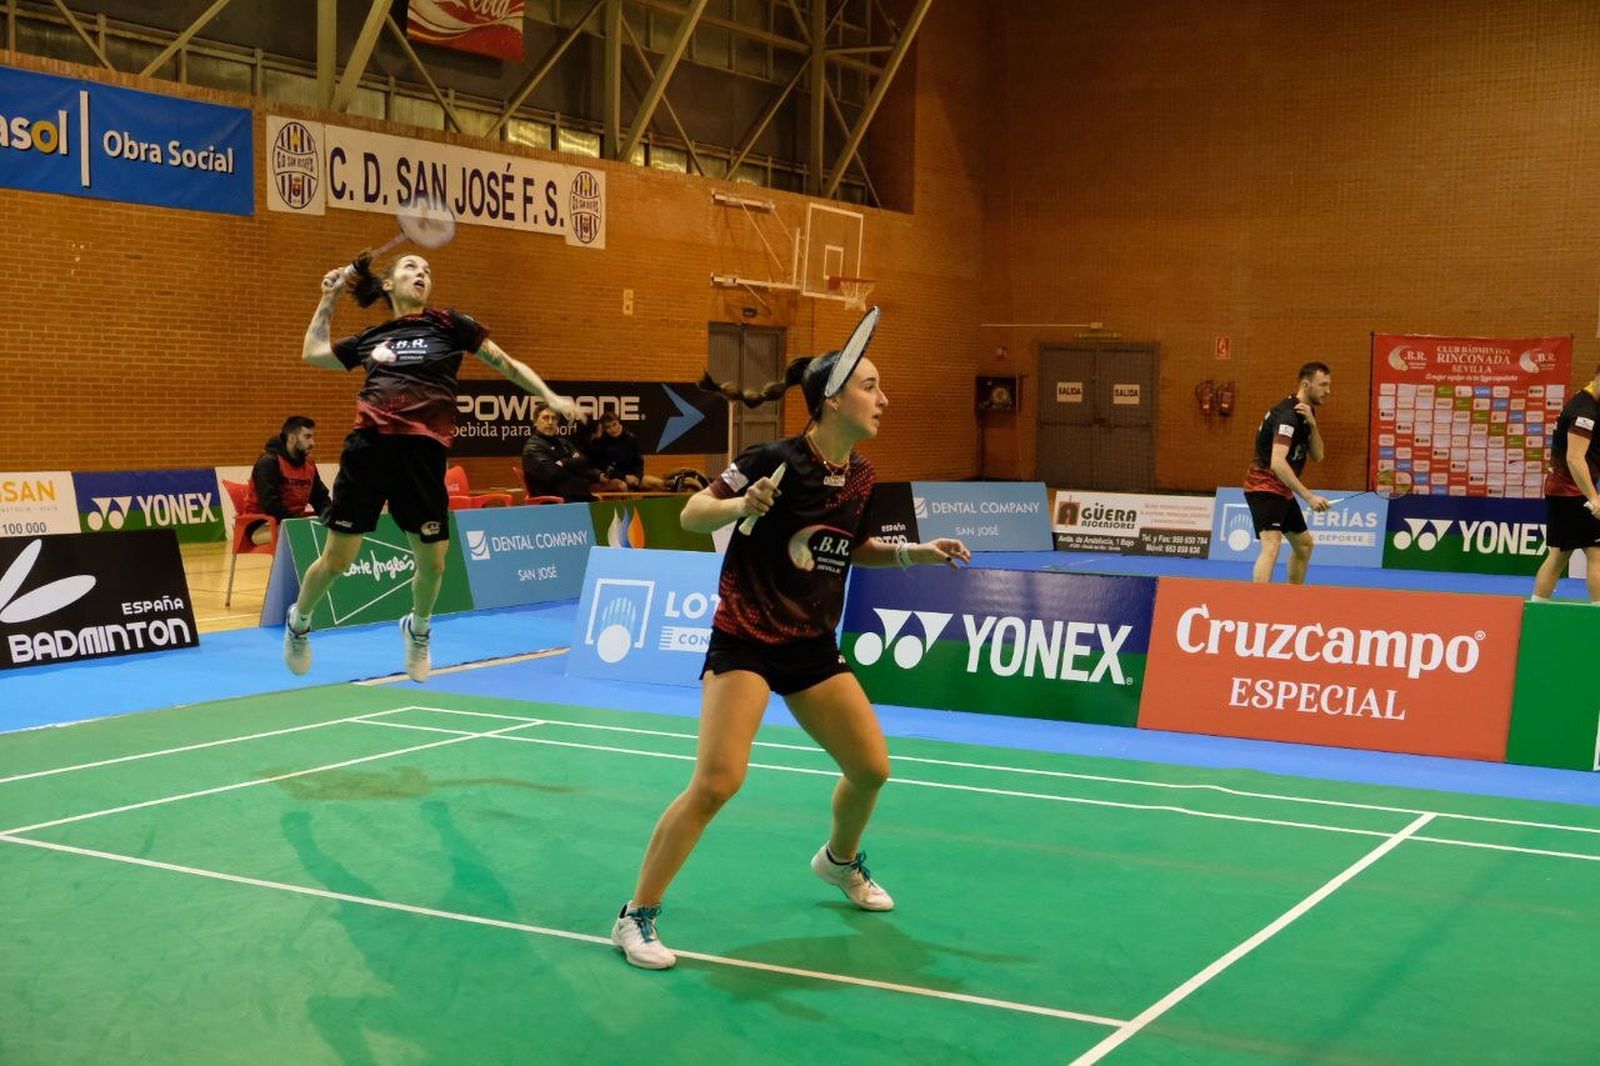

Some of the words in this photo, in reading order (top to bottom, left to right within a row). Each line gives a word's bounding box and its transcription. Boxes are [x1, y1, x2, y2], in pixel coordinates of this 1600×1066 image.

[103, 130, 162, 164] Obra
[168, 140, 234, 173] Social
[329, 146, 354, 201] C.
[363, 152, 388, 205] D.
[397, 157, 447, 211] SAN
[454, 162, 516, 222] JOSÉ
[523, 176, 538, 224] F.
[545, 180, 564, 227] S.
[1436, 345, 1460, 353] CLUB
[1436, 353, 1511, 365] RINCONADA
[1451, 364, 1492, 374] SEVILLA
[501, 425, 532, 440] para
[0, 480, 56, 502] SAN
[137, 492, 216, 527] YONEX
[932, 502, 977, 514] DENTAL
[979, 502, 1040, 515] COMPANY
[2, 523, 23, 534] 100
[26, 521, 47, 534] 000
[955, 526, 975, 536] SAN
[1081, 520, 1136, 530] ASCENSORES
[491, 534, 534, 552] DENTAL
[535, 530, 588, 548] COMPANY
[1319, 534, 1363, 542] DEPORTE
[342, 559, 373, 577] orte
[370, 549, 416, 581] Inglés
[518, 568, 536, 581] SAN
[121, 595, 185, 616] ESPAÑA
[8, 618, 192, 664] BADMINTON
[679, 634, 709, 646] CON
[1176, 604, 1480, 679] Cruzcampo
[962, 614, 1133, 685] YONEX
[1228, 677, 1406, 721] ESPECIAL
